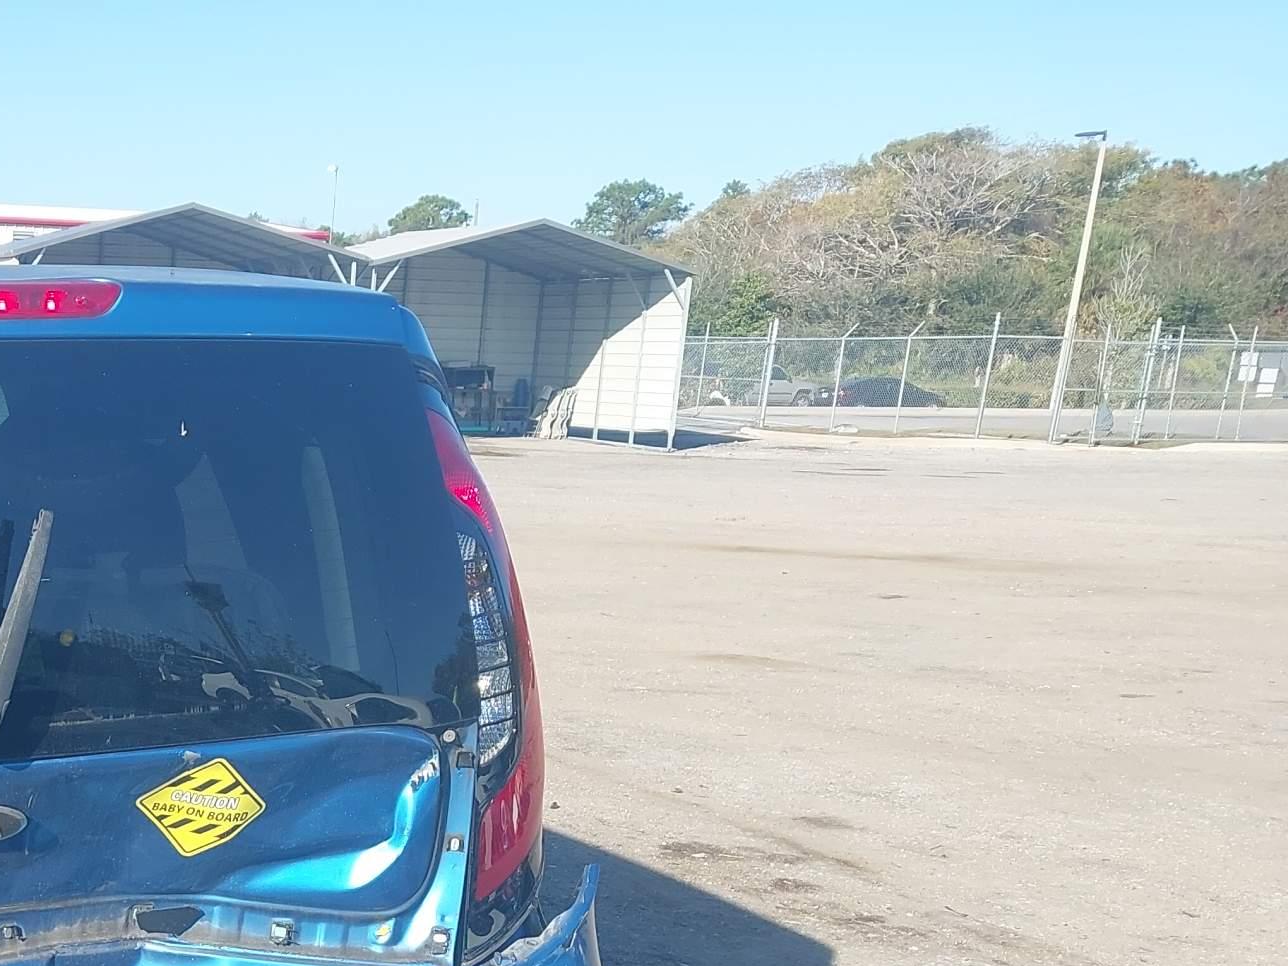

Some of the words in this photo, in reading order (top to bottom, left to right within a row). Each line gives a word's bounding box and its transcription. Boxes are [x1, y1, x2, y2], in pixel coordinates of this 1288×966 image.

[170, 789, 241, 810] CAUTION
[152, 802, 184, 813] BABY
[186, 806, 204, 818] ON
[206, 811, 249, 822] BOARD
